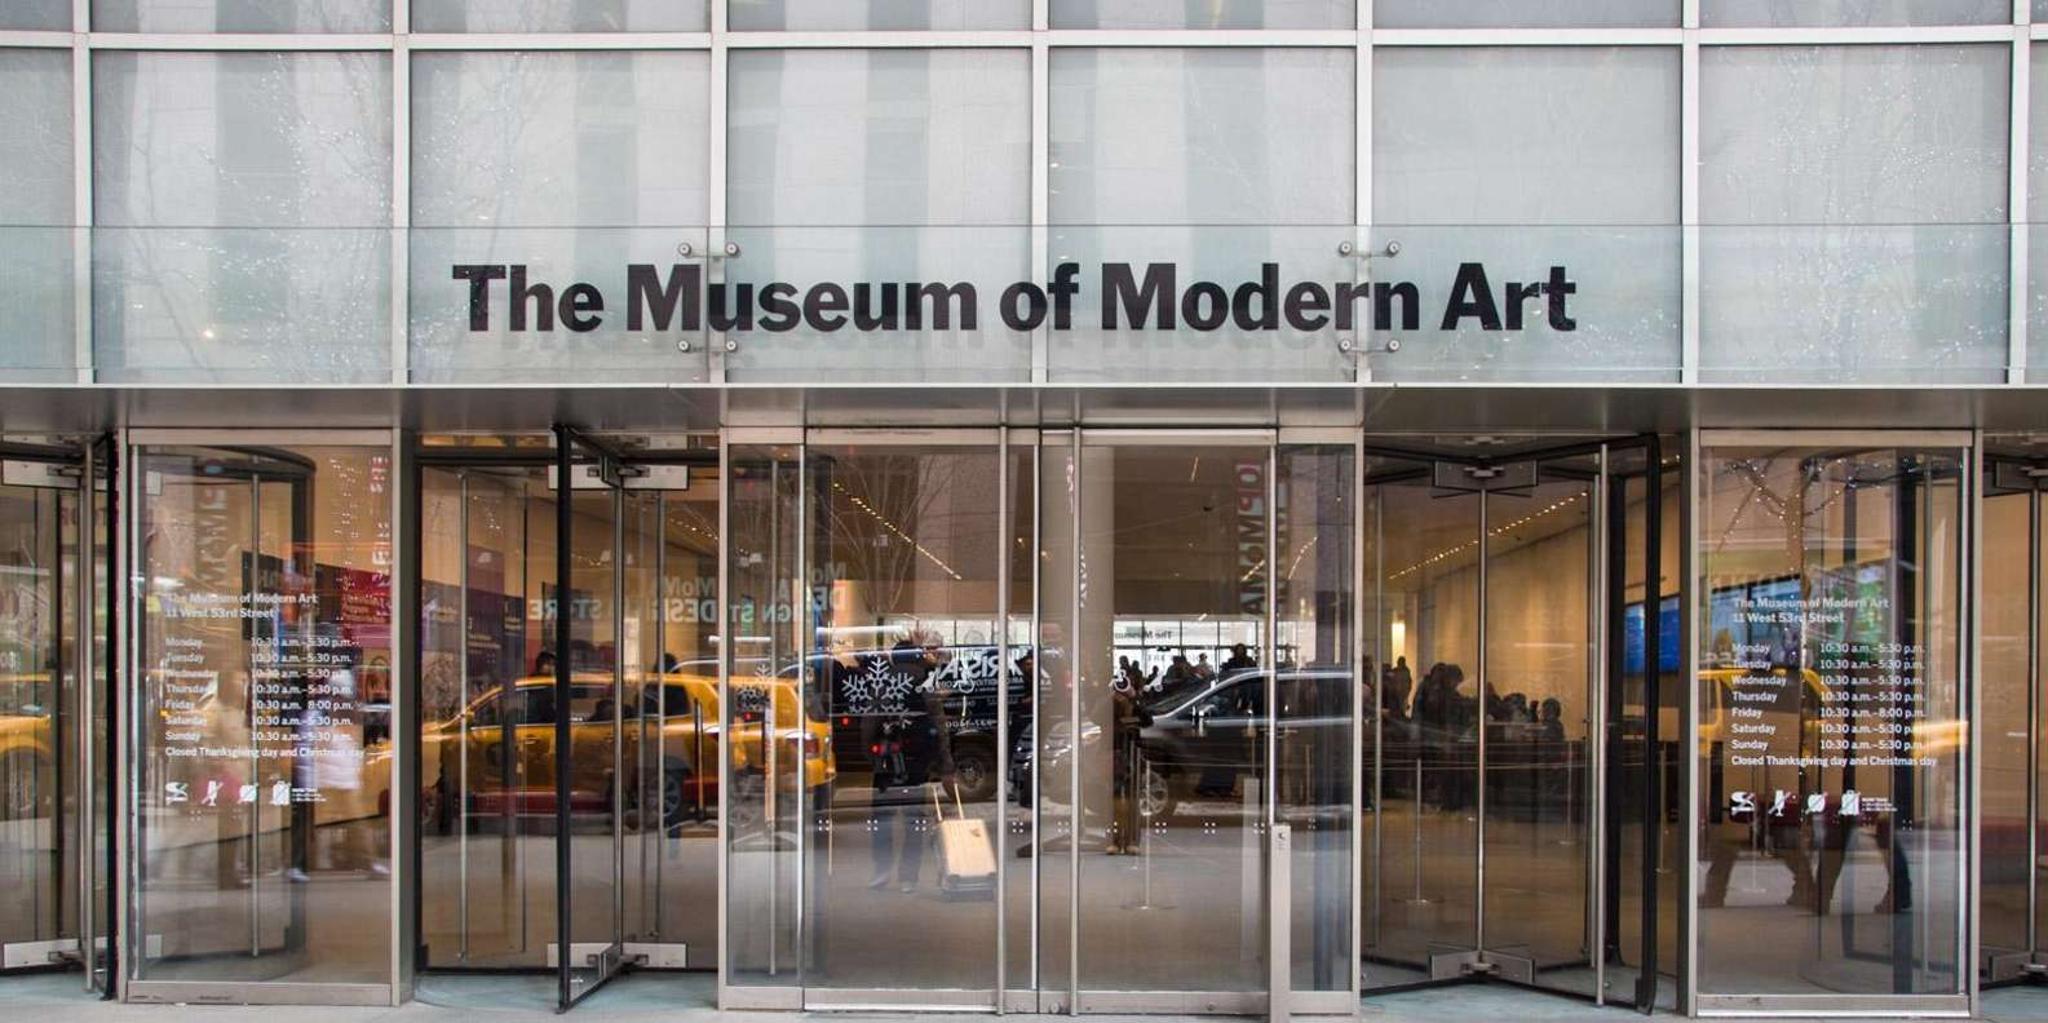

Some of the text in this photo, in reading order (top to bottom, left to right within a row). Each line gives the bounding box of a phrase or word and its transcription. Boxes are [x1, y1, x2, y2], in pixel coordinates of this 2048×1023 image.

[452, 262, 1577, 332] The Museum of Modern Art
[240, 592, 251, 603] of
[253, 592, 297, 603] Modern
[298, 592, 318, 603] Art
[1733, 598, 1889, 608] The Museum of Modern Art
[180, 607, 208, 618] West
[211, 607, 238, 618] 53rd
[240, 607, 276, 618] Street
[1733, 612, 1844, 623] 11 West 53rd Street
[165, 637, 203, 648] Monday
[1732, 643, 1771, 654] Monday
[1820, 643, 1849, 652] 10:30
[332, 654, 352, 664] p.m.
[1732, 660, 1771, 672] Tuesday
[1820, 660, 1849, 669] 10:30
[1732, 675, 1787, 687] Wednesday
[1820, 676, 1849, 685] 10:30
[1732, 691, 1777, 703] Thursday
[1820, 692, 1849, 701] 10:30
[165, 700, 196, 711] Friday
[332, 701, 353, 711] p.m.
[1732, 707, 1762, 719] Friday
[1820, 708, 1849, 717] 10:30
[332, 717, 353, 727] p.m.
[1732, 723, 1776, 735] Saturday
[1820, 724, 1849, 733] 10:30
[1904, 725, 1924, 735] p.
[165, 732, 200, 743] Sunday
[1732, 739, 1768, 751] Sunday
[1820, 740, 1849, 749] 10:30
[165, 747, 197, 756] Closed
[199, 747, 259, 758] Thanksgiving
[261, 748, 278, 758] day
[280, 748, 298, 756] and
[1731, 755, 1937, 767] Closed Thanksgiving day and Christmas day
